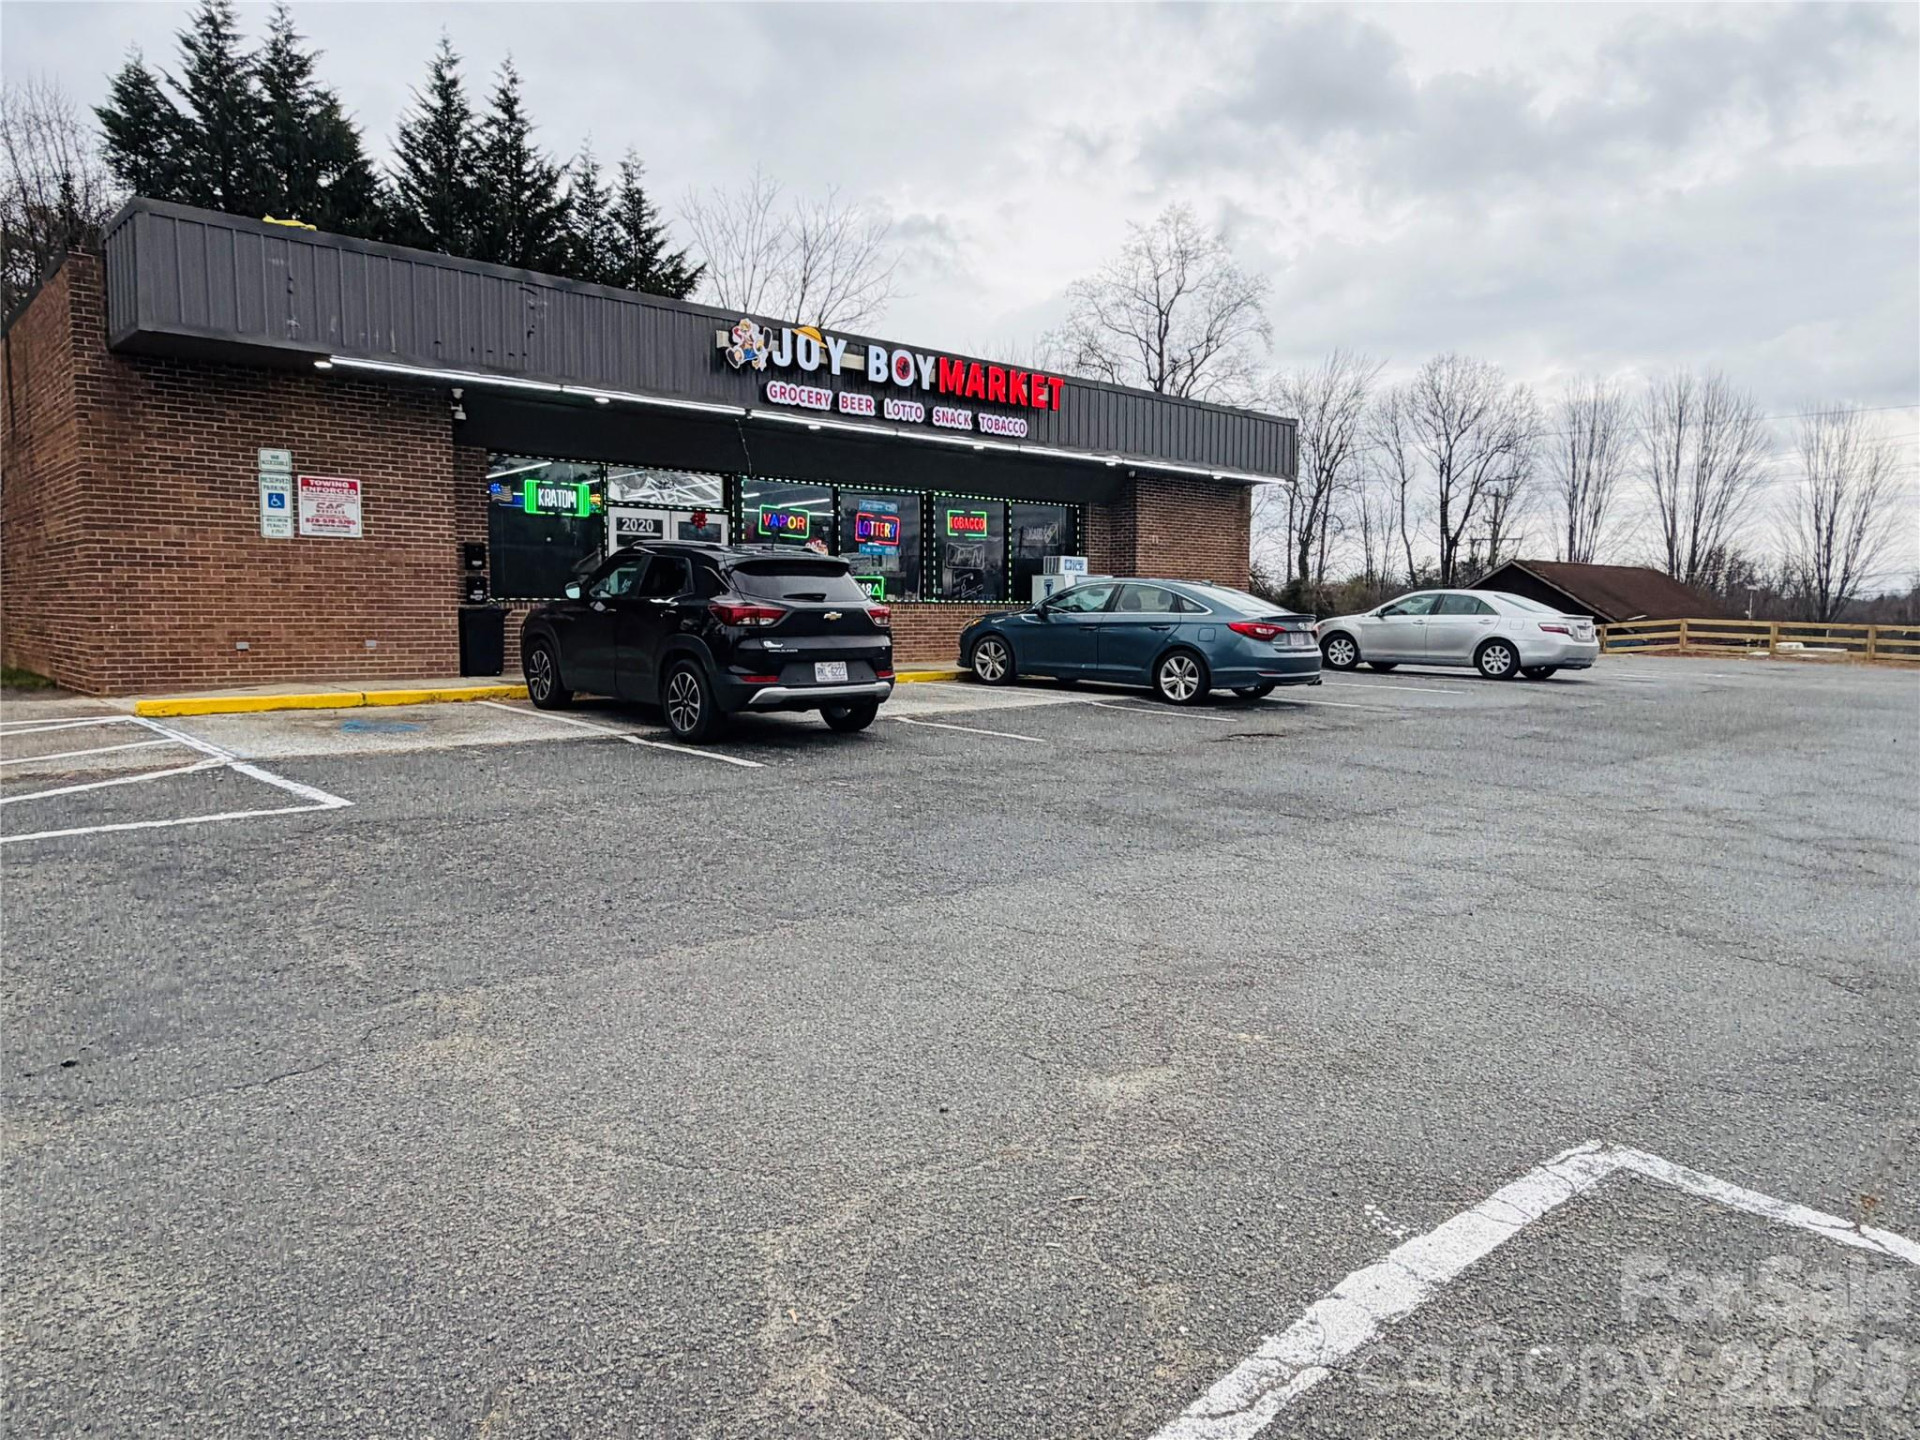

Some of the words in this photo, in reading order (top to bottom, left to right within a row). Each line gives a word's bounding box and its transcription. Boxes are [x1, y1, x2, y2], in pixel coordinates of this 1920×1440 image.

[772, 327, 848, 375] JOY
[868, 344, 935, 390] BOY
[938, 356, 1064, 411] MARKET
[767, 381, 832, 410] GROCERY
[840, 394, 874, 414] BEER
[885, 399, 924, 423] LOTTO
[934, 408, 973, 429] SNACK
[981, 416, 1027, 436] TOBACCO
[302, 487, 356, 495] ENFORCED
[309, 480, 350, 488] TOWING
[538, 488, 577, 508] KRATOM
[622, 518, 654, 533] 2020
[762, 513, 806, 531] VAPOR
[858, 520, 896, 539] LOTTERY
[950, 516, 986, 531] TOBACCO
